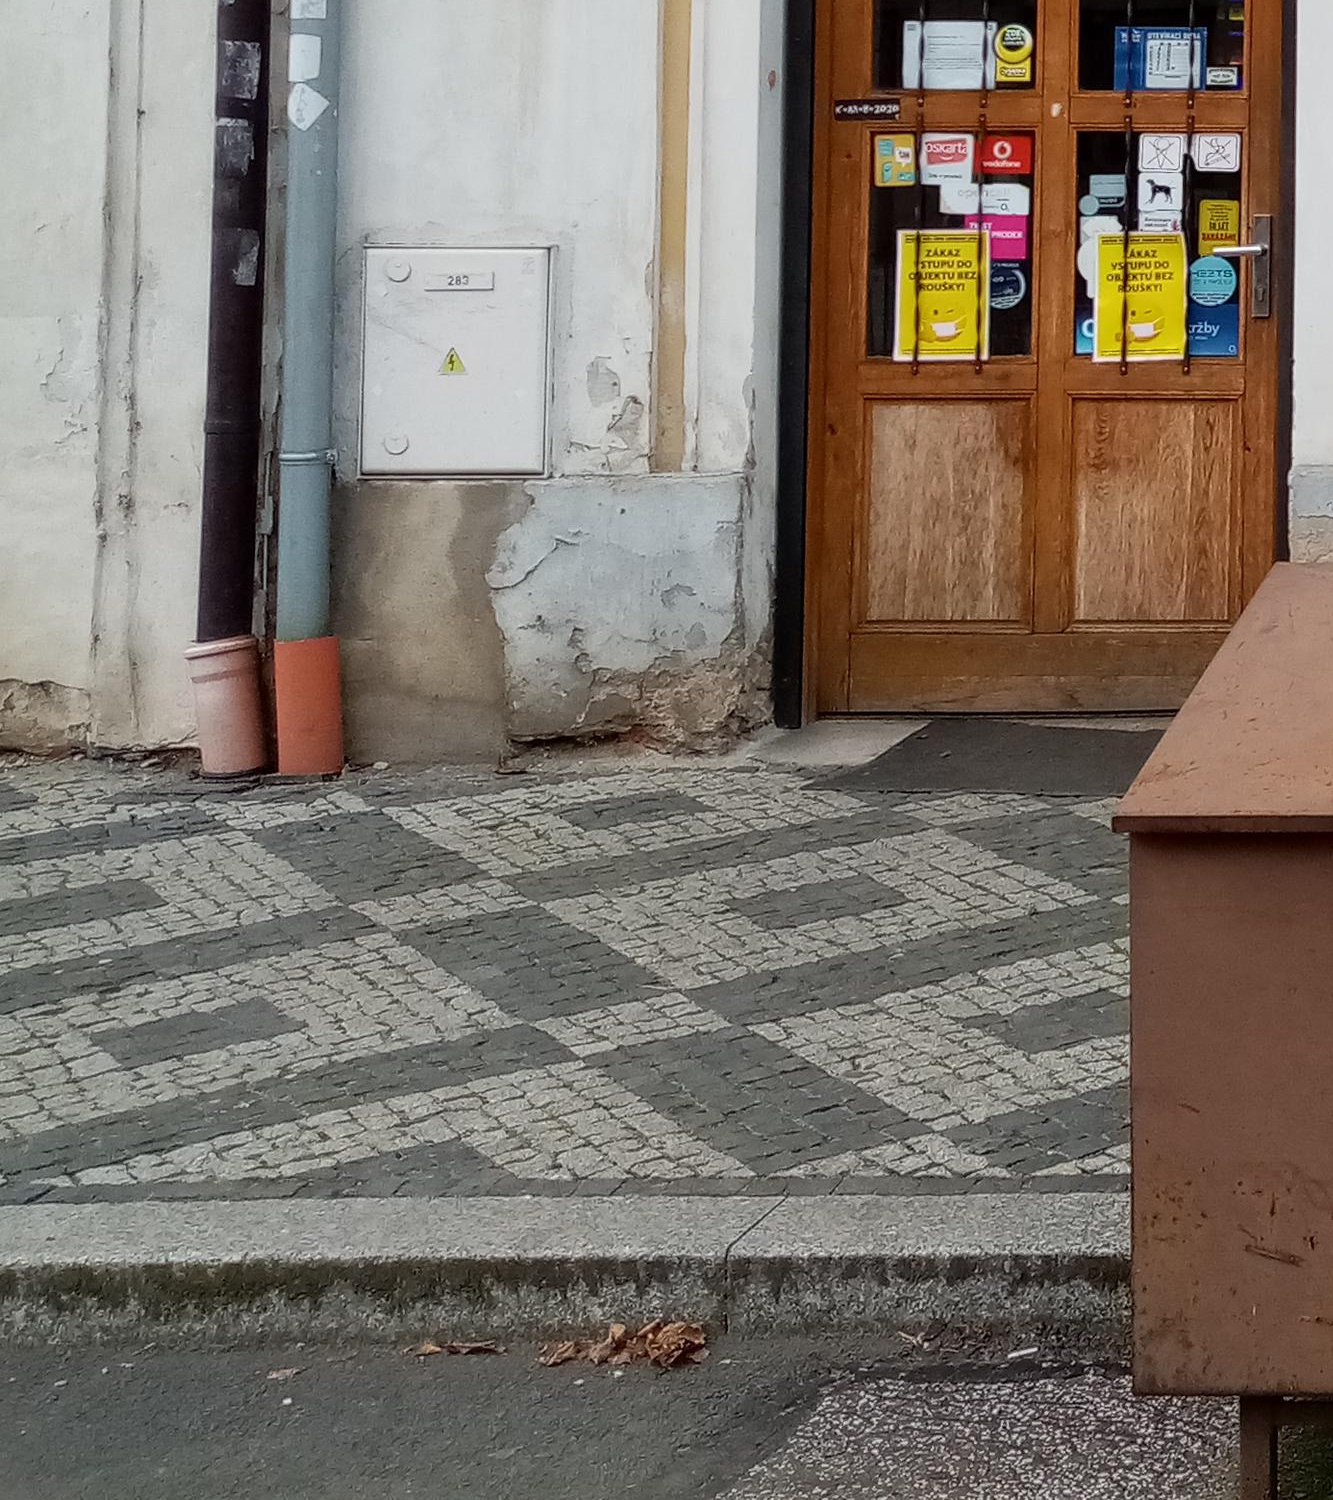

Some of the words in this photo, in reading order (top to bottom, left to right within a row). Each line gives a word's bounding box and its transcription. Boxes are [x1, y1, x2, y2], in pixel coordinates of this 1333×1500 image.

[925, 248, 961, 258] ZÁKAZ
[914, 260, 955, 269] STUPU
[956, 260, 973, 269] DO
[1154, 260, 1170, 269] DO
[908, 271, 955, 281] OJEKTU
[1155, 272, 1174, 281] BEZ
[447, 275, 470, 287] 283
